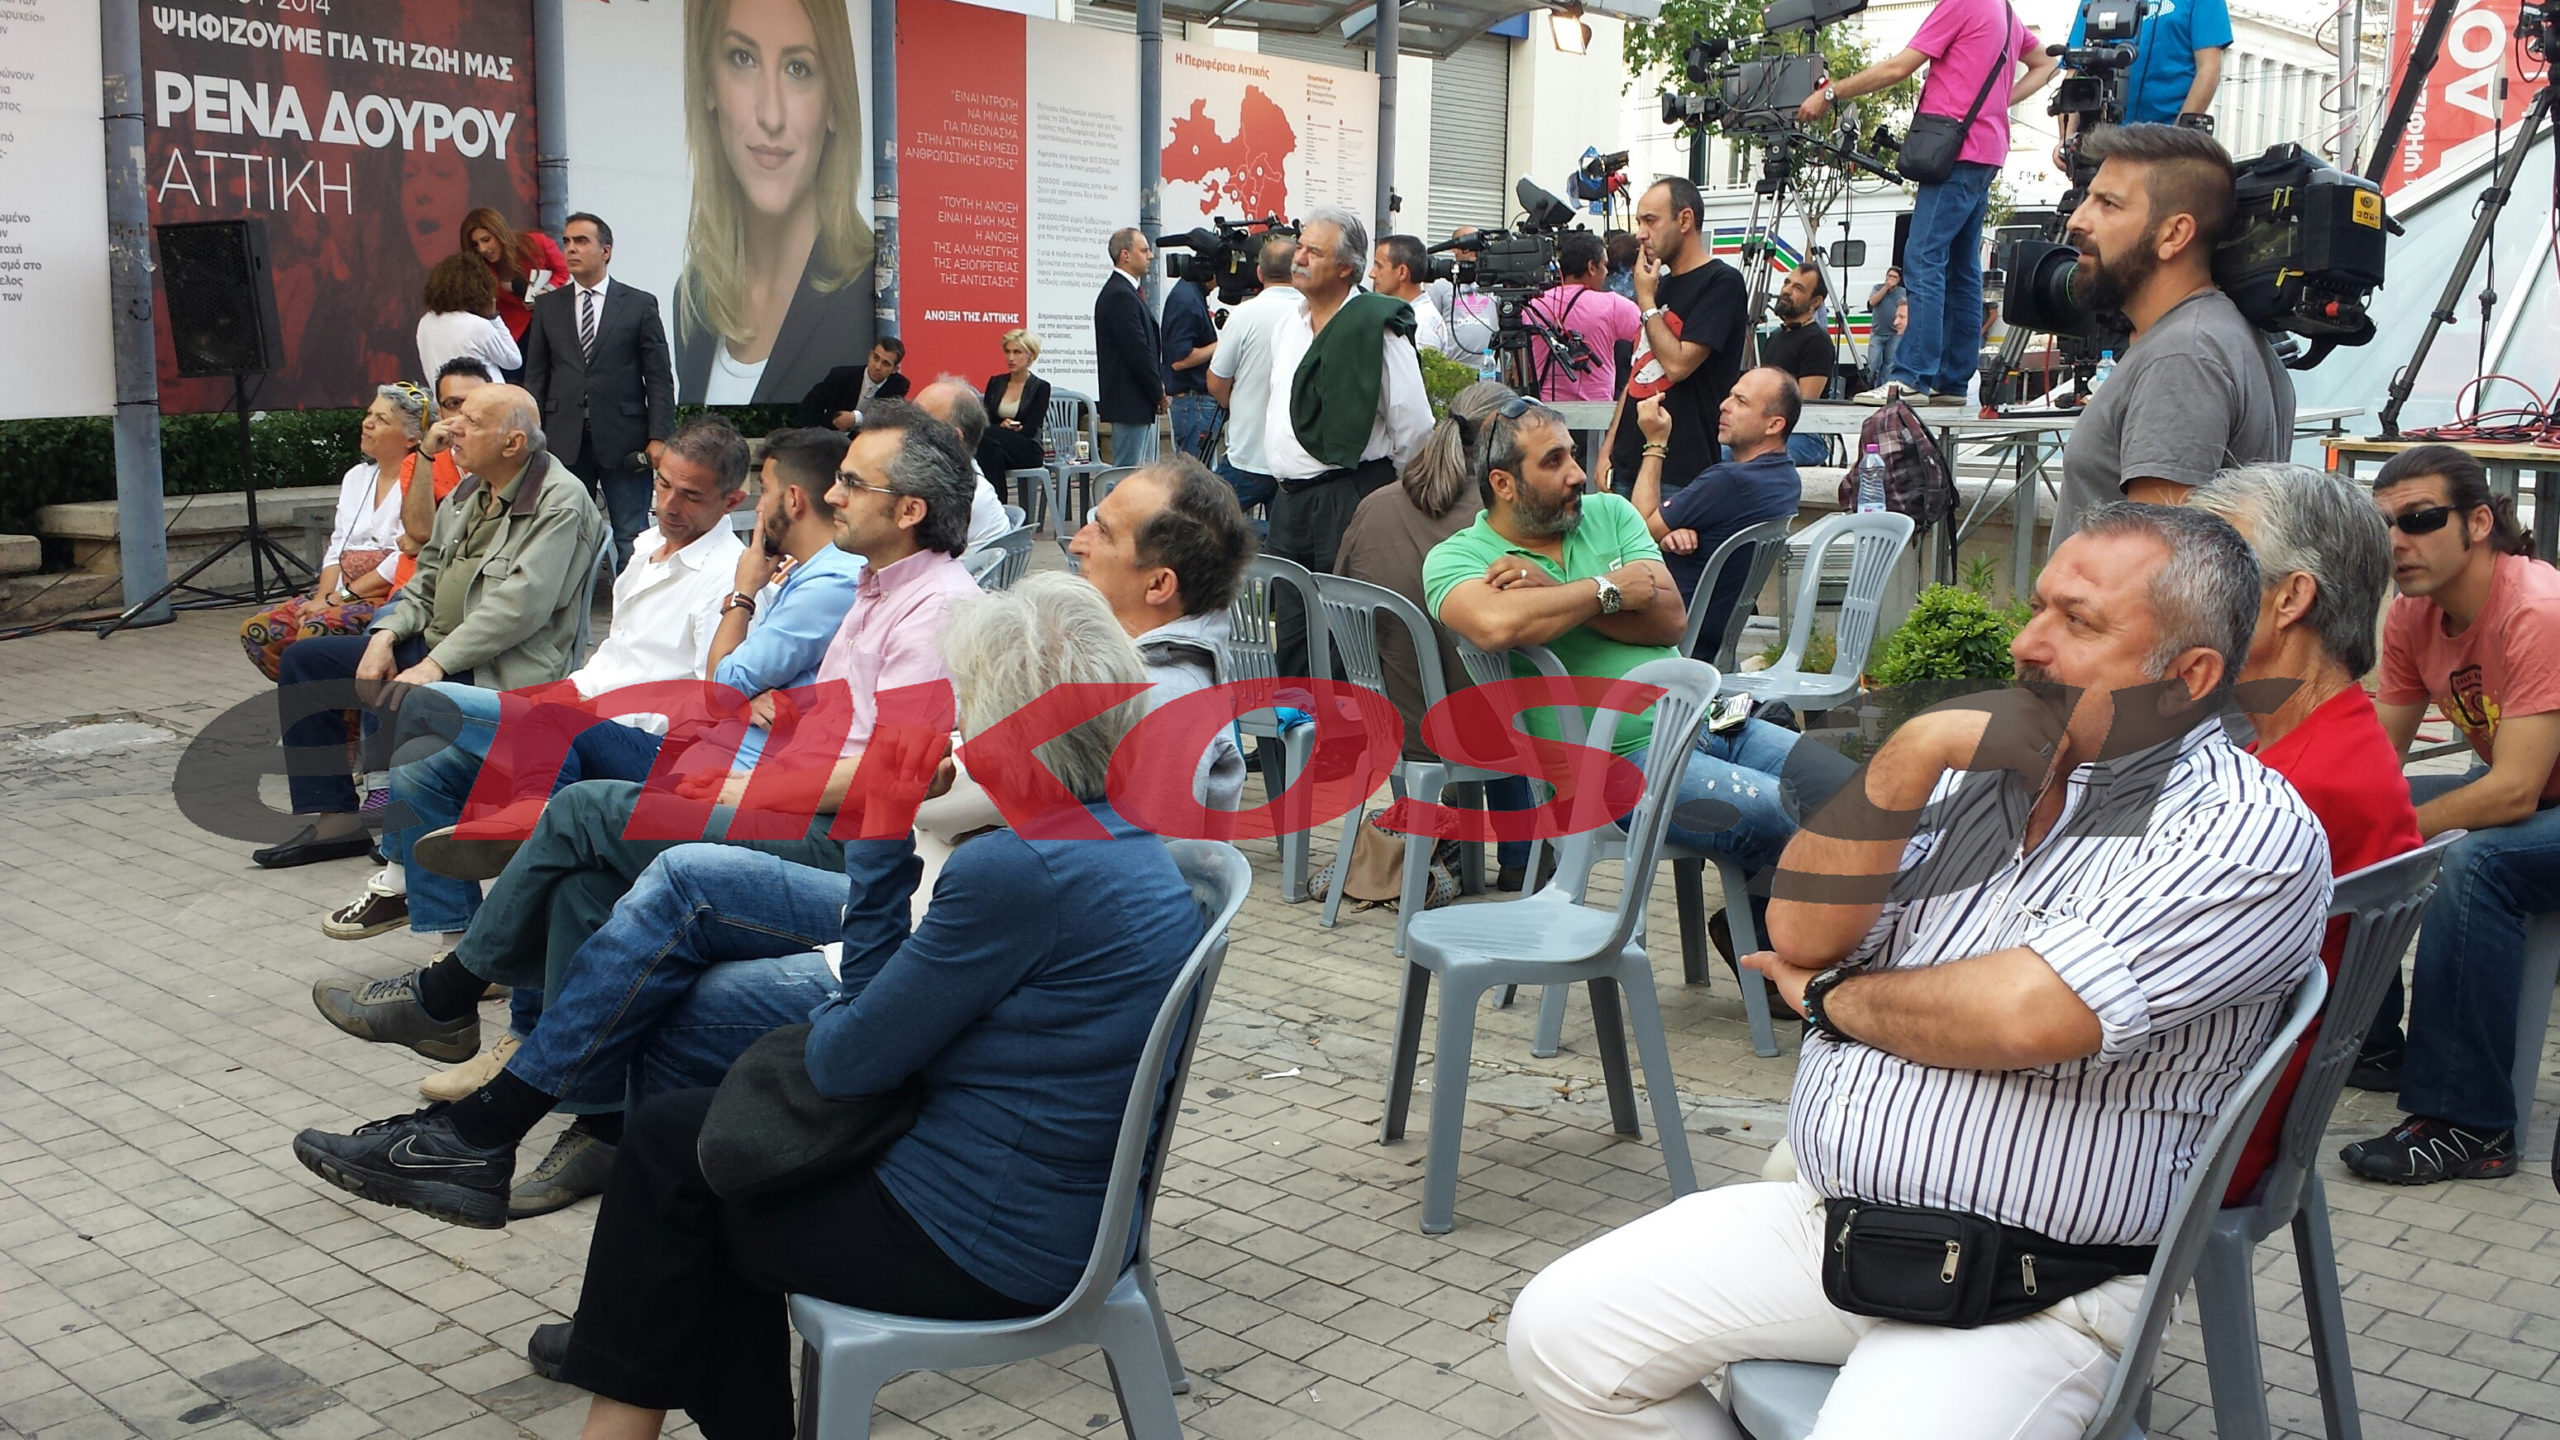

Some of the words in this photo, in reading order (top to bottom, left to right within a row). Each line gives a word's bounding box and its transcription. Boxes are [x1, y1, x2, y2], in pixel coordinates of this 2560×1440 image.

[152, 6, 321, 55] ΨΗΦΙΖΟΥΜΕ
[328, 32, 368, 61] ΓΙΑ
[373, 38, 404, 66] ΤΗ
[410, 43, 459, 74] ΖΩΗ
[465, 52, 514, 81] ΜΑΣ
[1175, 53, 1183, 64] Η
[1185, 54, 1236, 73] Περιφέρεια
[1238, 63, 1270, 80] Αττικής
[981, 94, 1018, 109] ΝΤΡΟΠΗ
[155, 70, 313, 141] ΡΕΝΑ
[319, 91, 516, 160] ΔΟΥΡΟΥ
[968, 108, 981, 120] ΝΑ
[983, 110, 1018, 125] ΜΙΛΑΜΕ
[943, 120, 959, 133] ΓΙΑ
[961, 122, 1019, 140] ΠΛΕΟΝΑΣΜΑ
[916, 132, 942, 145] ΣΤΗΝ
[945, 136, 977, 150] ΑΤΤΙΚΗ
[979, 140, 992, 152] ΕΝ
[993, 142, 1019, 156] ΜΕΣΩ
[905, 147, 981, 167] ΑΝΘΡΩΠΙΣΤΙΚΗΣ
[157, 148, 352, 215] ΑΤΤΙΚΗ
[976, 200, 982, 210] Η
[984, 201, 1019, 214] ΑΝΟΙΞΗ
[938, 211, 963, 224] ΕΙΝΑΙ
[965, 214, 972, 224] Η
[974, 215, 996, 226] ΔΙΚΗ
[976, 231, 982, 240] Η
[984, 231, 1019, 243] ΑΝΟΙΞΗ
[933, 241, 951, 254] ΤΗΣ
[954, 243, 1019, 259] ΑΛΛΗΛΕΓΓΥΗΣ
[933, 257, 951, 269] ΤΗΣ
[954, 259, 1019, 273] ΑΞΙΟΠΡΕΠΕΙΑΣ
[940, 272, 958, 284] ΤΗΣ
[2, 293, 23, 301] των
[924, 310, 961, 322] ΑΝΟΙΞΗ
[963, 311, 980, 322] ΤΗΣ
[982, 312, 1019, 324] ΑΤΤΙΚΗΣ
